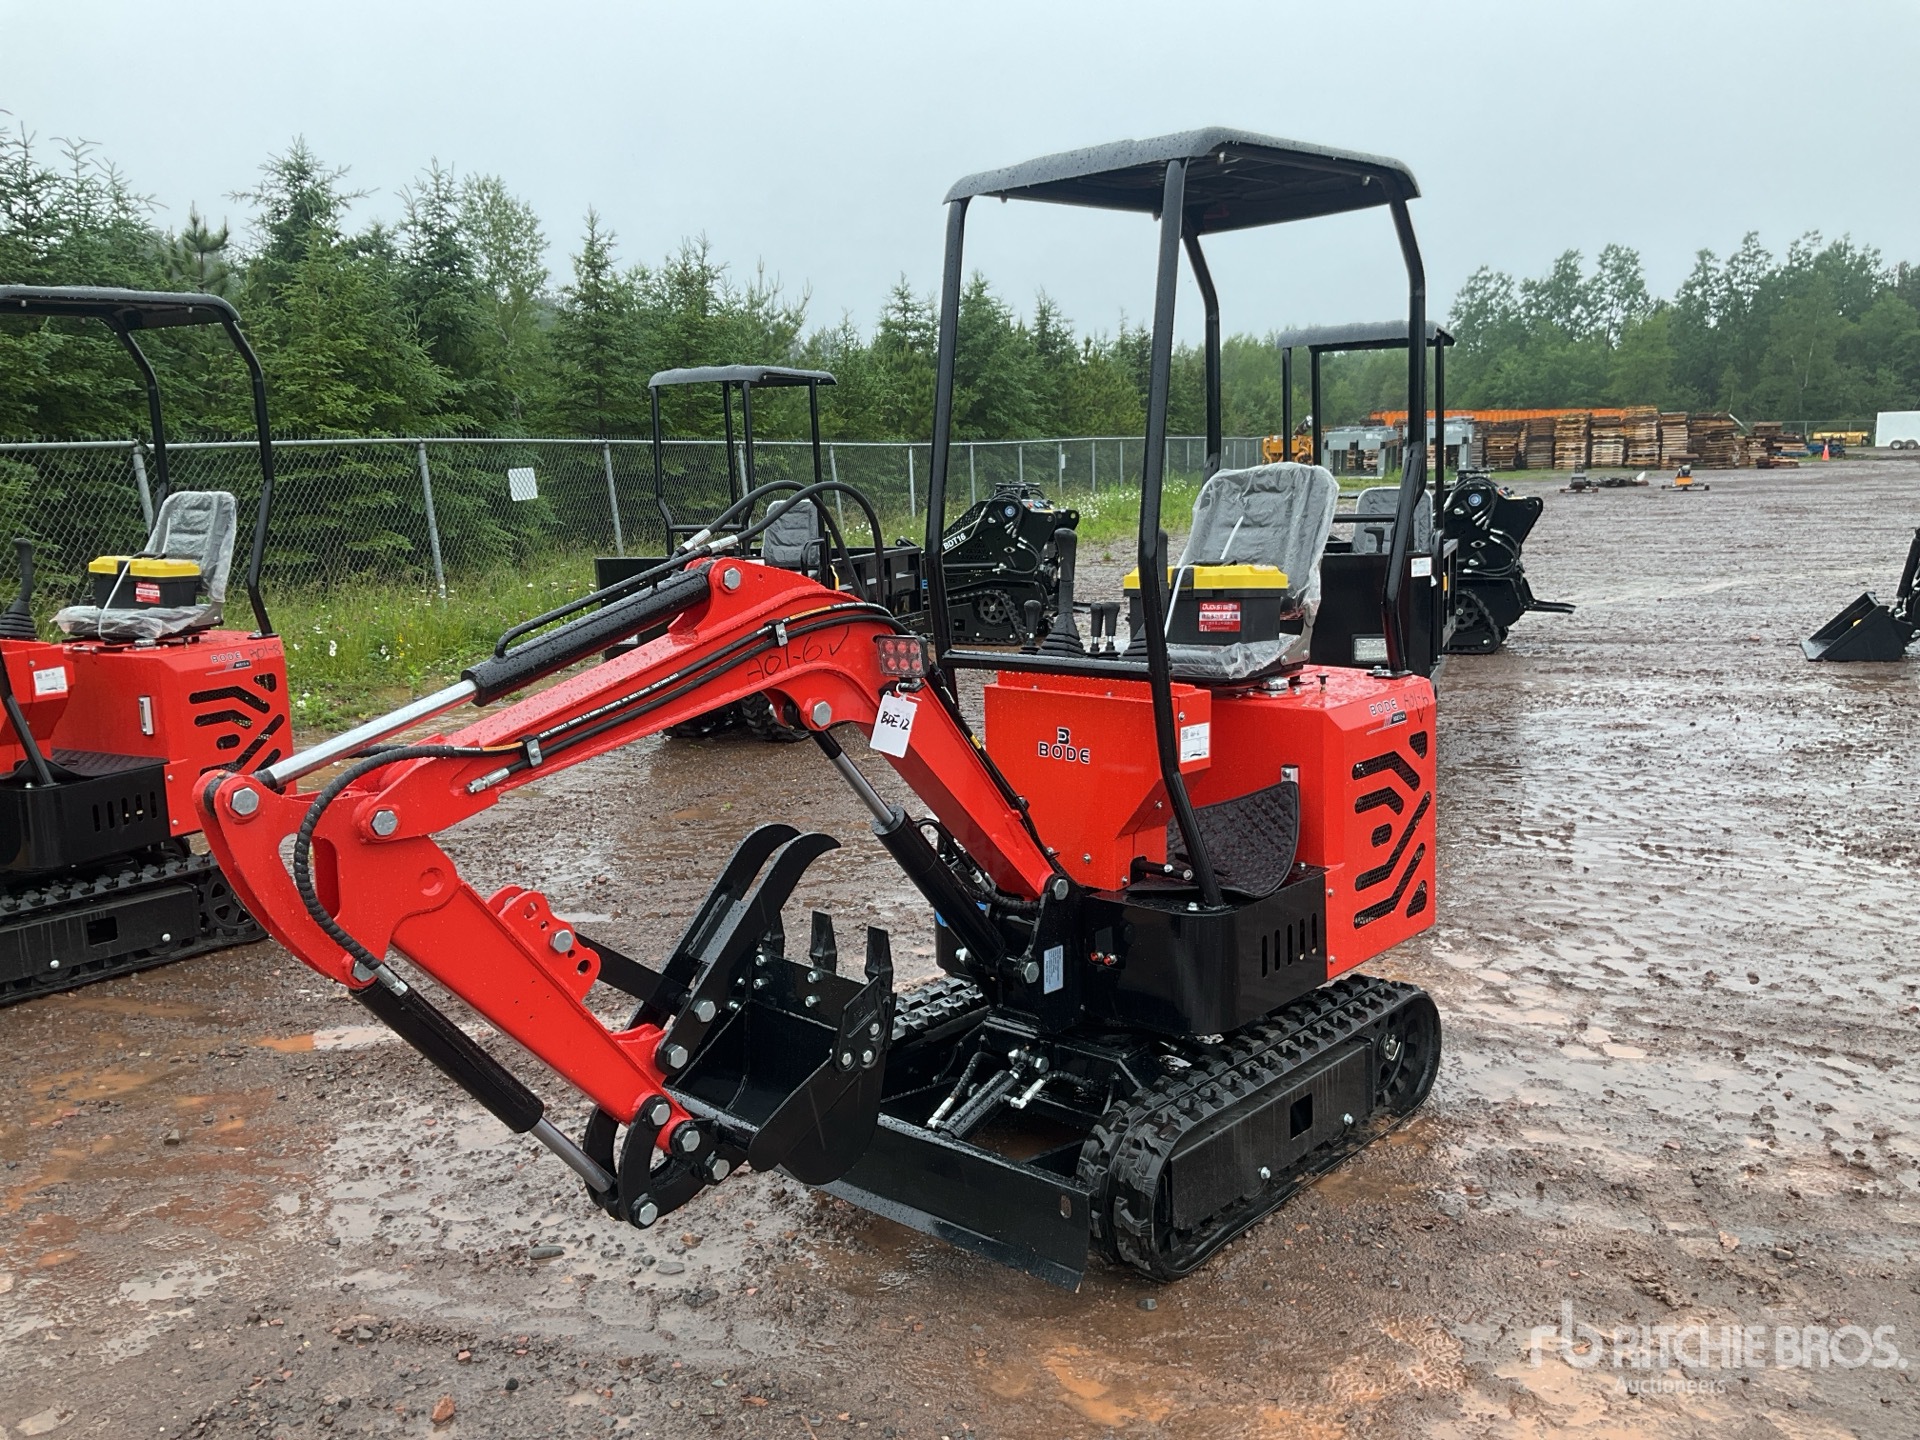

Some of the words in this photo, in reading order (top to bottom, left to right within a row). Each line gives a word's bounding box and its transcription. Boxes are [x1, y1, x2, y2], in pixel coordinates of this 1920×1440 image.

[943, 532, 966, 550] BDT16
[211, 651, 242, 664] BODE
[1369, 698, 1398, 716] BODE
[1038, 741, 1090, 765] BODE
